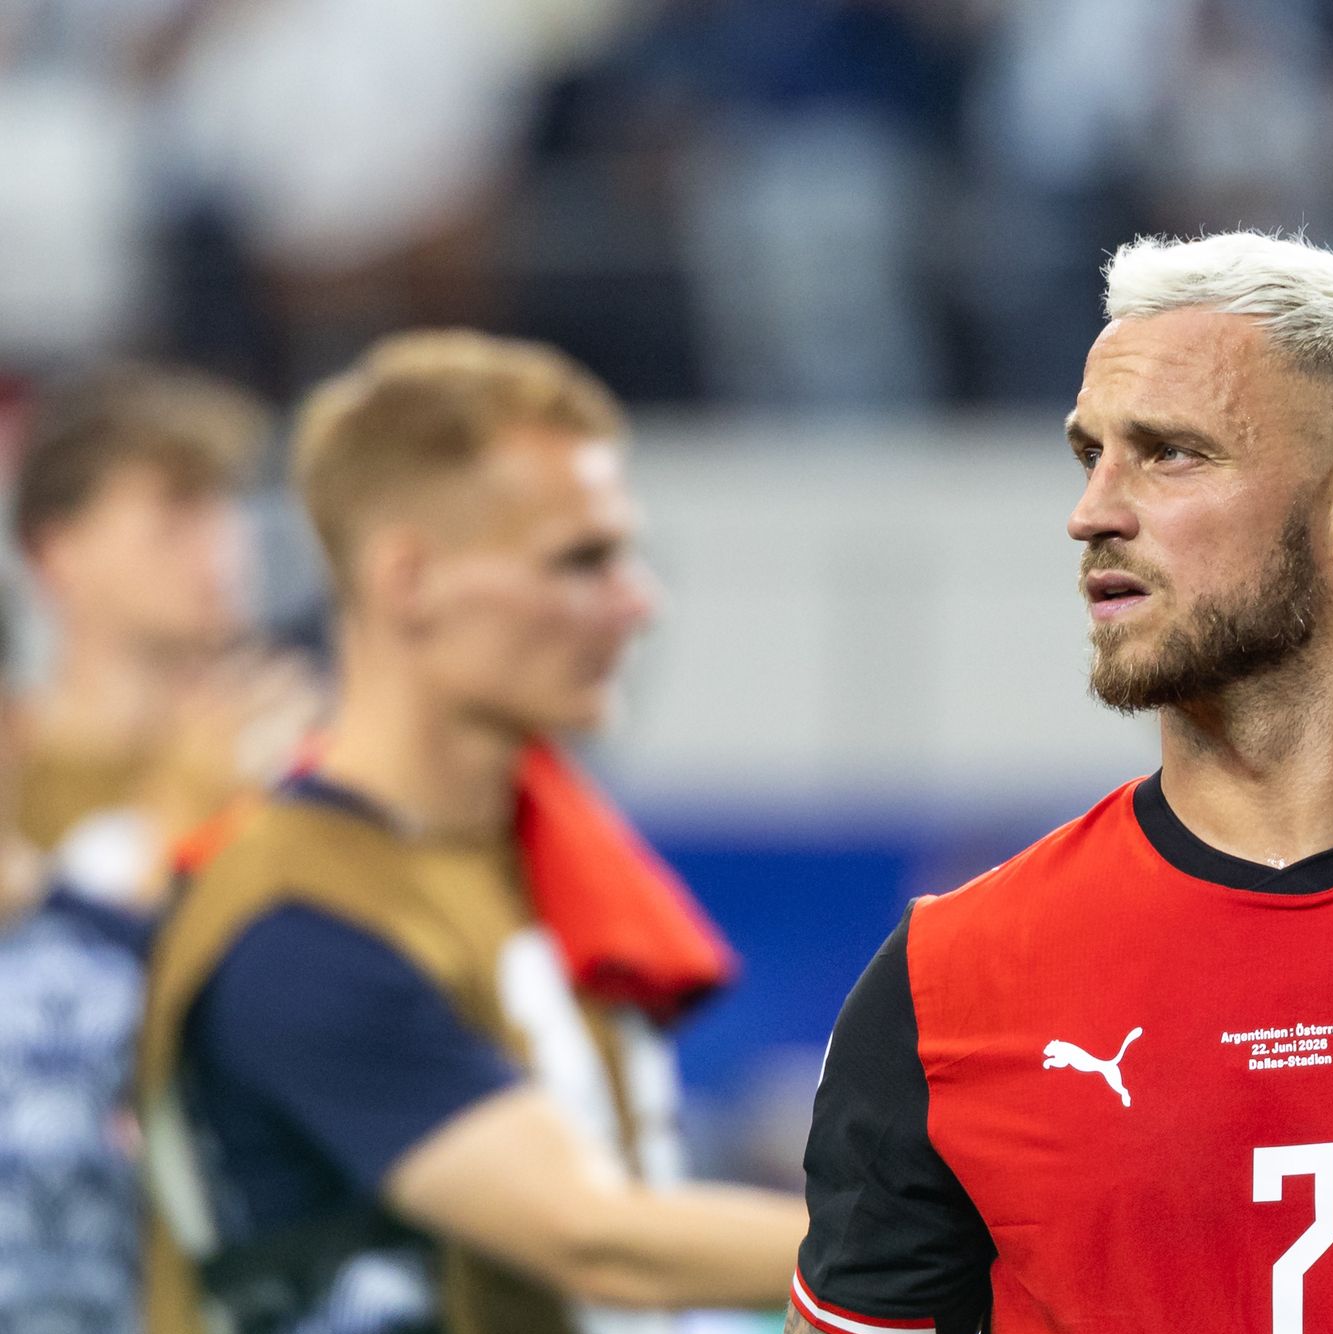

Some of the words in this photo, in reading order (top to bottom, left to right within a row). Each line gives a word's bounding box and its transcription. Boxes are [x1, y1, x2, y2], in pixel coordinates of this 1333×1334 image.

[1221, 1028, 1288, 1044] Argentinien
[1251, 1044, 1270, 1055] 22.
[1272, 1041, 1297, 1054] Juni
[1298, 1038, 1328, 1051] 2026
[1248, 1054, 1332, 1070] Dallas-Stadion
